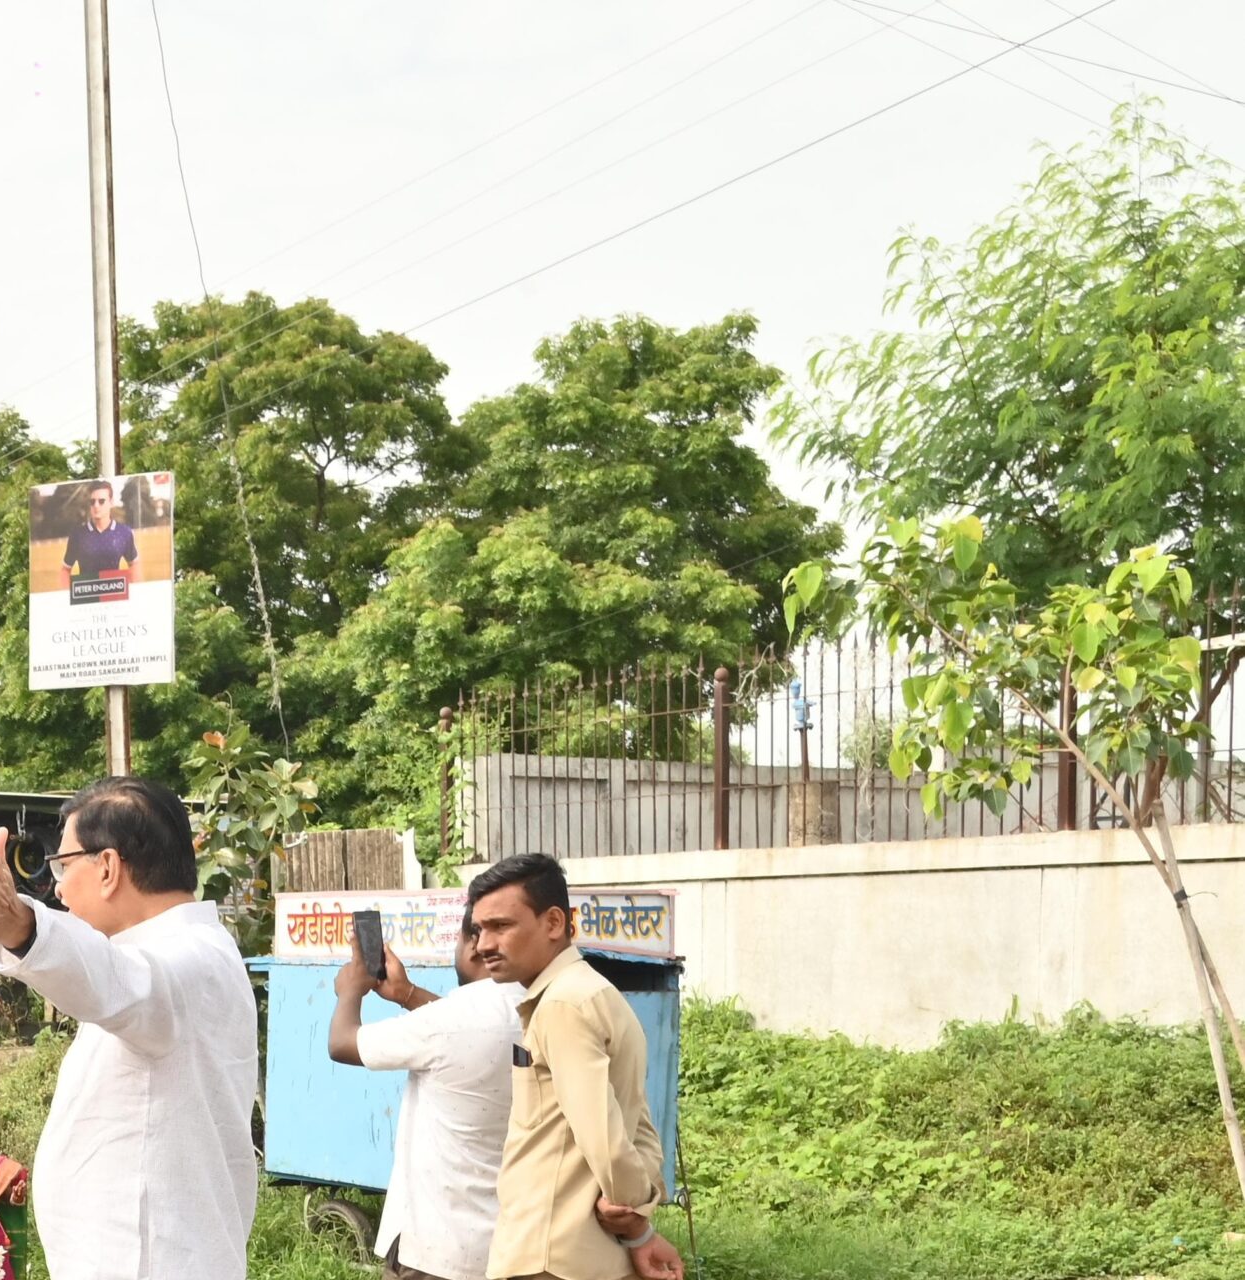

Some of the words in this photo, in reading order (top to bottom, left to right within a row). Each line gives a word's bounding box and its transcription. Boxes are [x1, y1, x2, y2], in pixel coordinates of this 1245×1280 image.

[75, 584, 92, 594] PETER
[93, 581, 124, 593] ENGLAND
[92, 615, 107, 624] THE
[52, 624, 148, 644] GENTLEMEN'S
[73, 641, 127, 657] LEAGUE
[33, 662, 71, 672] RAJASTHAN
[100, 659, 117, 668] NEAR
[78, 670, 97, 678] ROAD
[581, 895, 617, 938] भेळ
